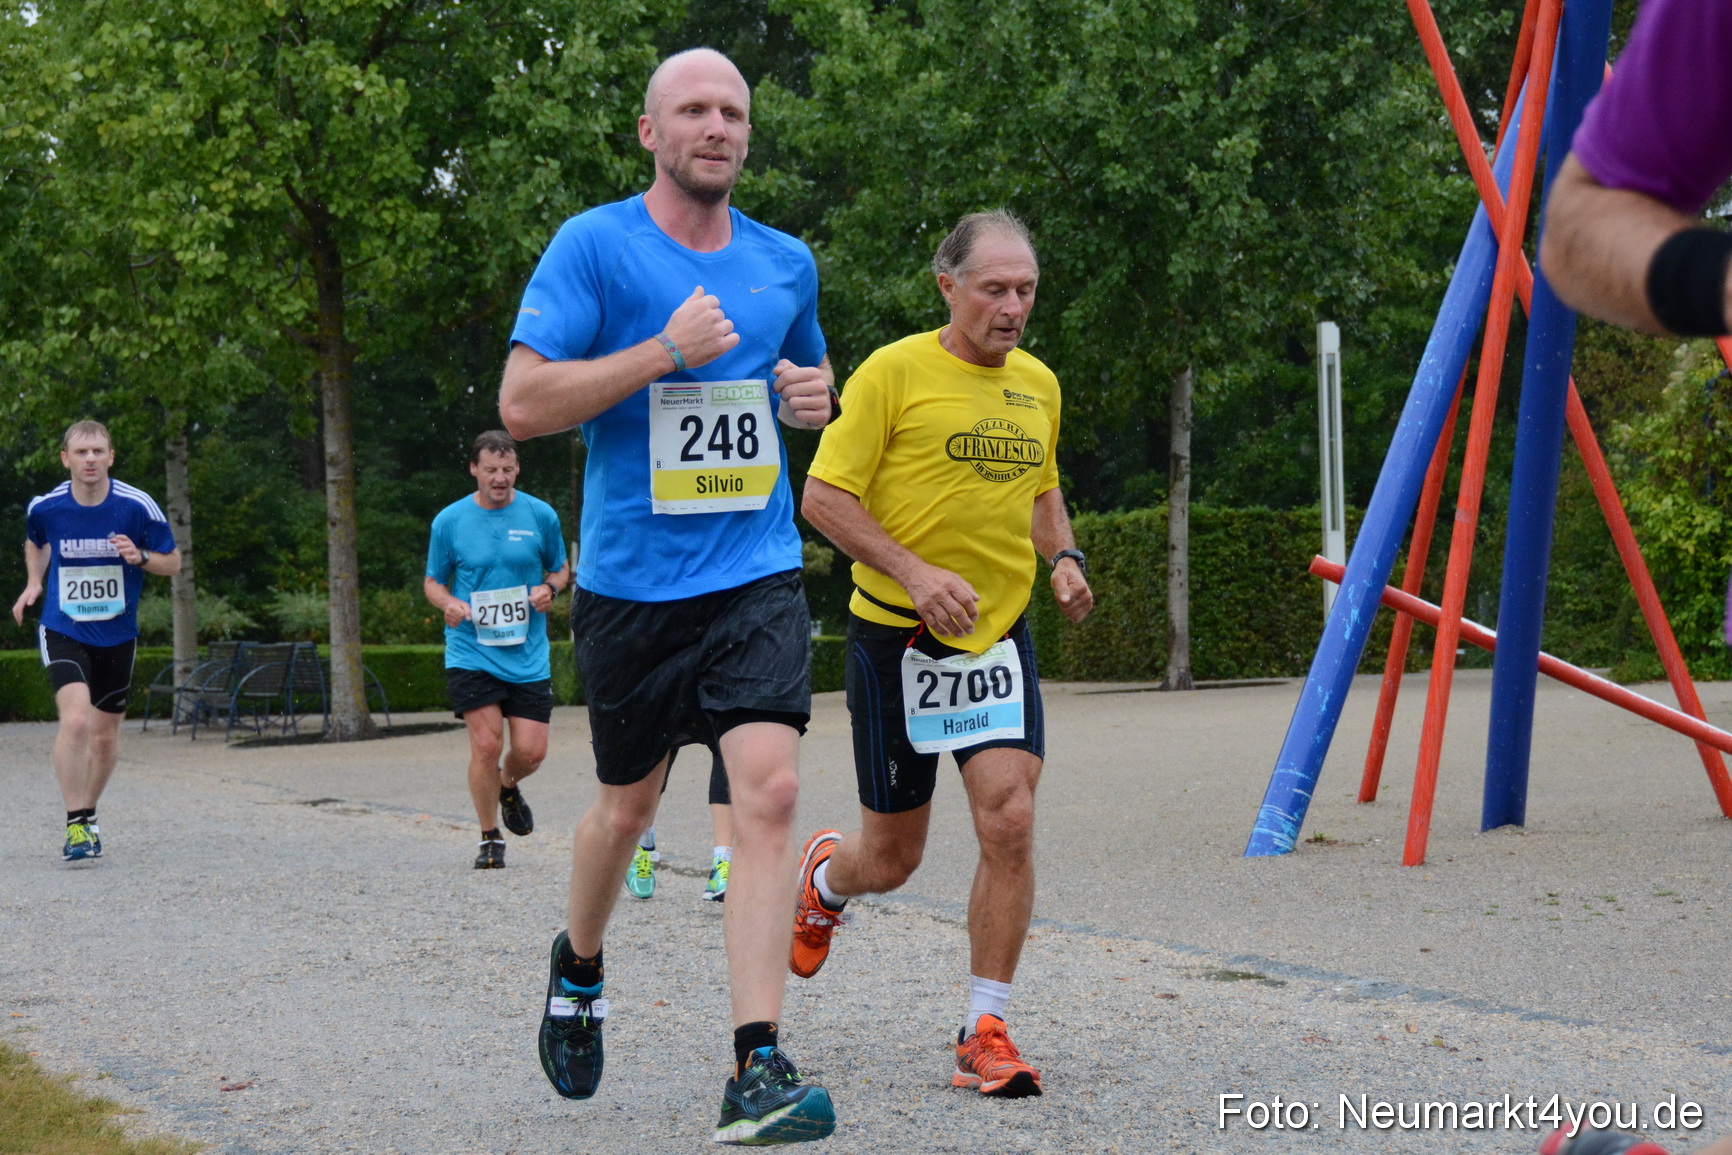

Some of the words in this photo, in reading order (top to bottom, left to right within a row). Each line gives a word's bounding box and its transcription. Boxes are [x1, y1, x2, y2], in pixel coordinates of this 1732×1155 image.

[660, 398, 704, 406] NeuerMarkt
[711, 385, 764, 401] BOCK
[680, 412, 759, 462] 248
[974, 420, 1024, 440] PIZZERIA
[962, 437, 1037, 462] FRANCESCO
[656, 460, 662, 469] B
[696, 474, 744, 494] Silvio
[67, 579, 118, 600] 2050
[77, 604, 109, 613] Thomas
[479, 601, 526, 625] 2795
[493, 630, 515, 638] Claus
[916, 665, 1013, 709] 2700
[910, 707, 916, 715] B
[943, 711, 989, 735] Harald
